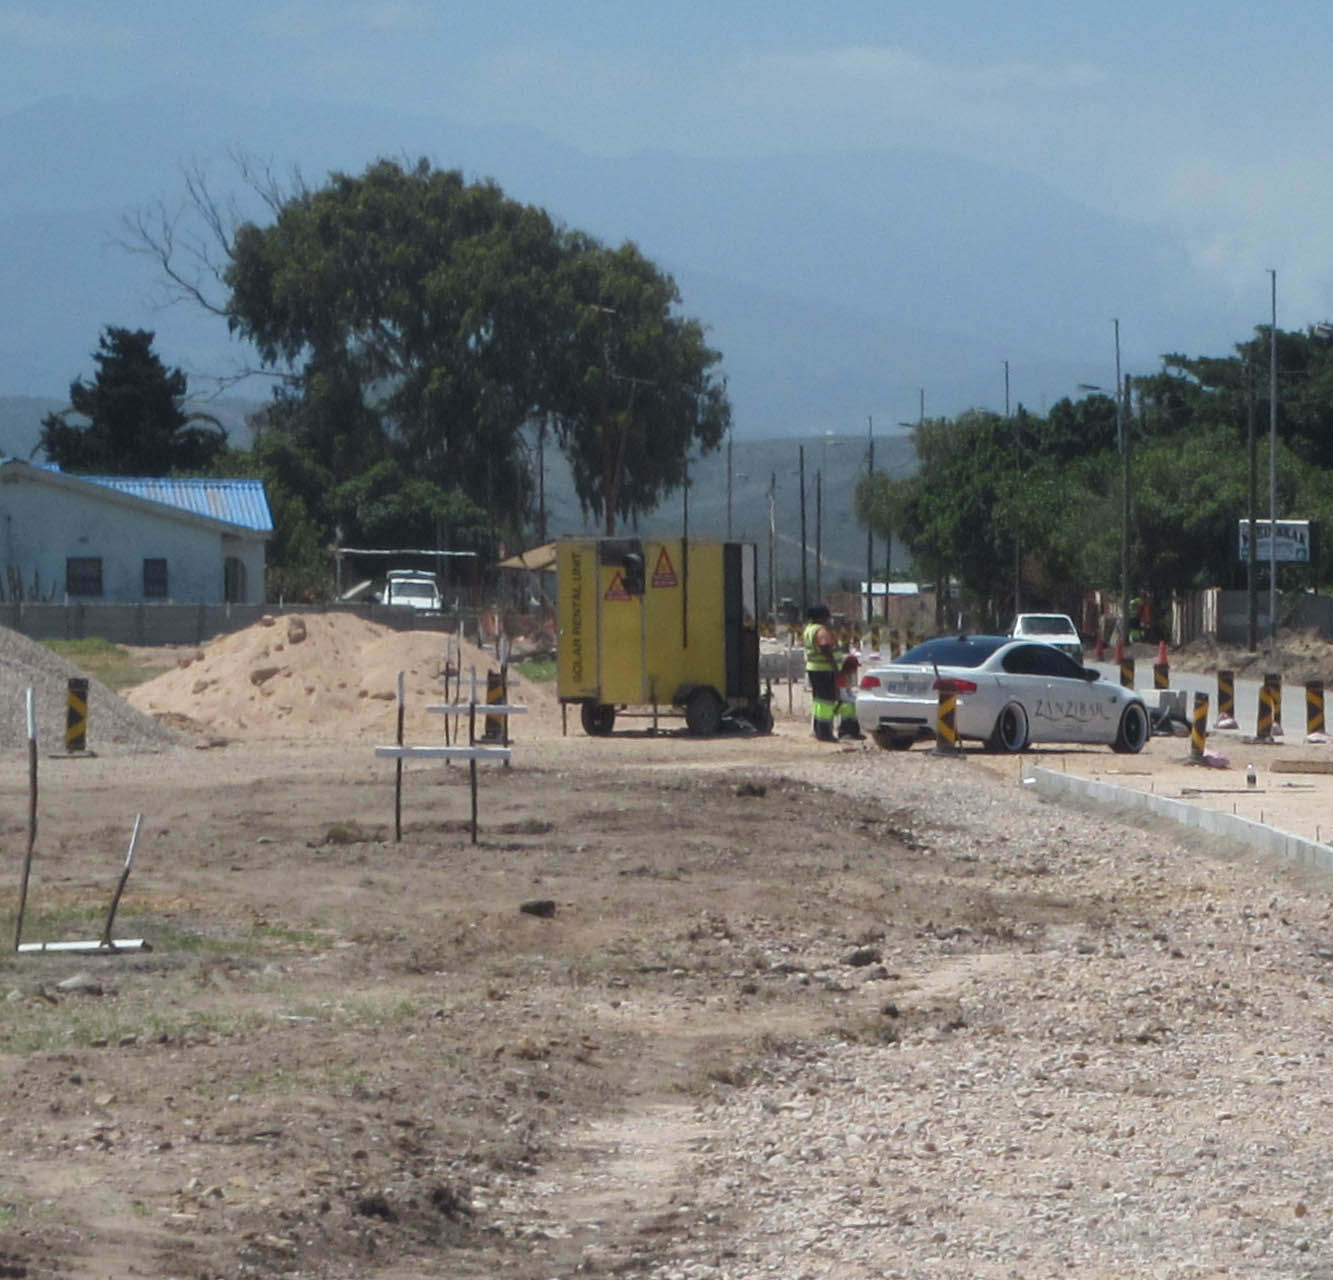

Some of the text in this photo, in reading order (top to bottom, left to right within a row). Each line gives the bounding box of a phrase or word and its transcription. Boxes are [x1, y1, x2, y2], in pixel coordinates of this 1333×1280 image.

[572, 552, 582, 581] UNIT
[571, 584, 582, 636] RENTAL
[1035, 699, 1111, 722] ZANZIBAR
